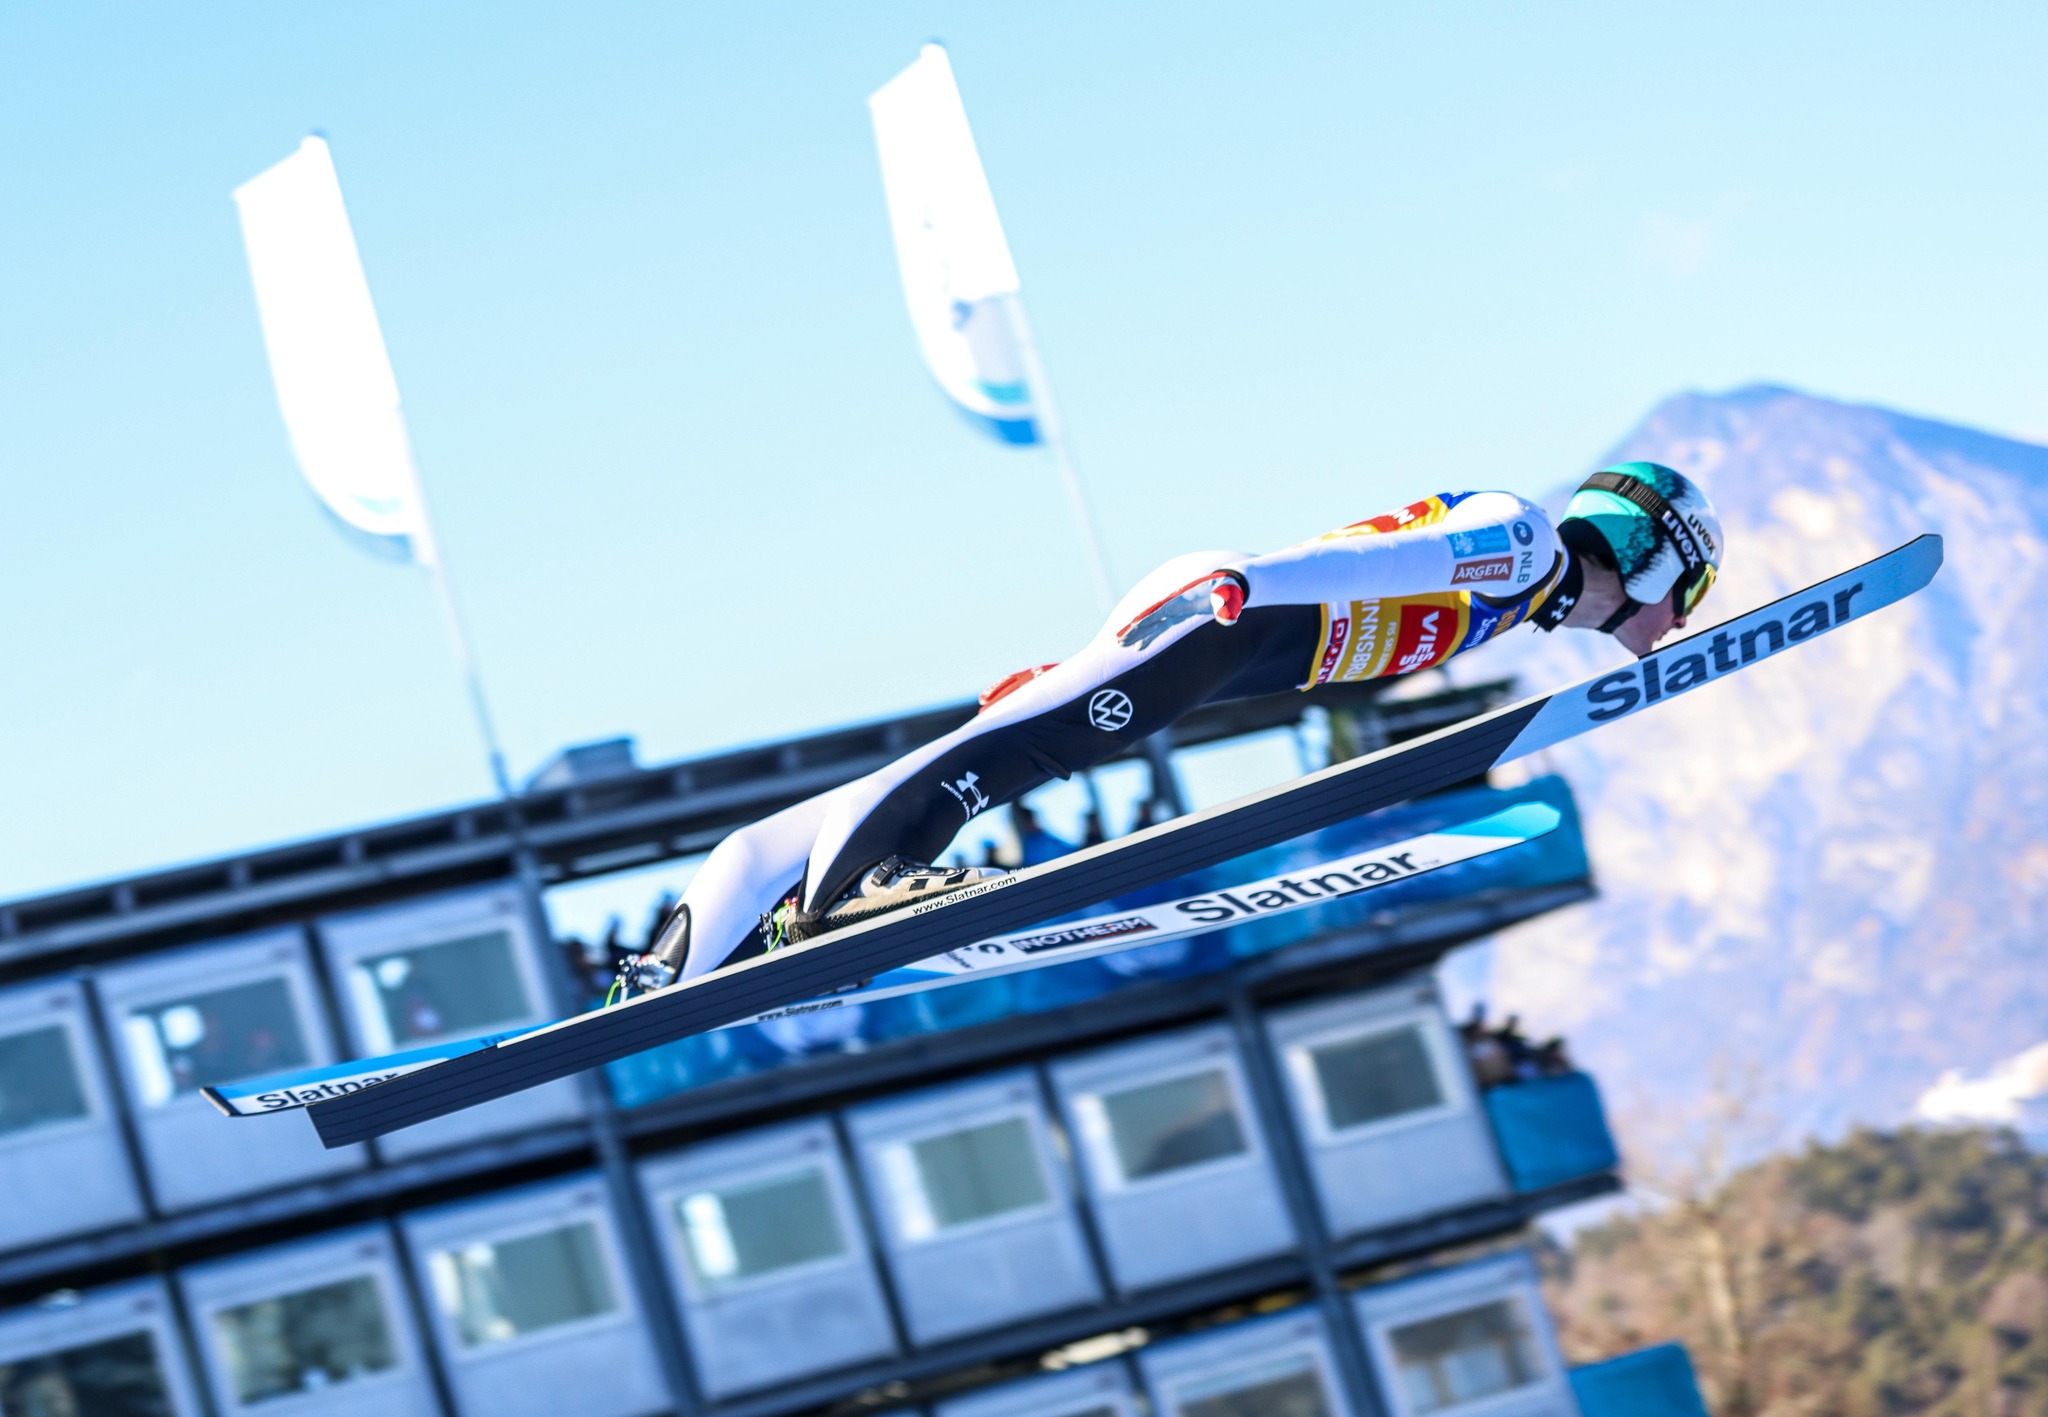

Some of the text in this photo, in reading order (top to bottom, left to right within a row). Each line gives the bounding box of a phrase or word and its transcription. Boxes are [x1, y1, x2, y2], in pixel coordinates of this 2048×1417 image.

[1662, 509, 1700, 569] uvex
[1687, 514, 1715, 555] uvex
[1454, 562, 1510, 580] ARGETA
[1517, 551, 1533, 583] NLB
[1587, 582, 1863, 721] Slatnar
[941, 781, 964, 801] UNDER
[913, 876, 1017, 915] www.Slatnar.com
[1176, 851, 1417, 923] Slatnar
[1012, 916, 1150, 951] INOTHERM
[757, 1000, 844, 1021] www.Slatnar.com
